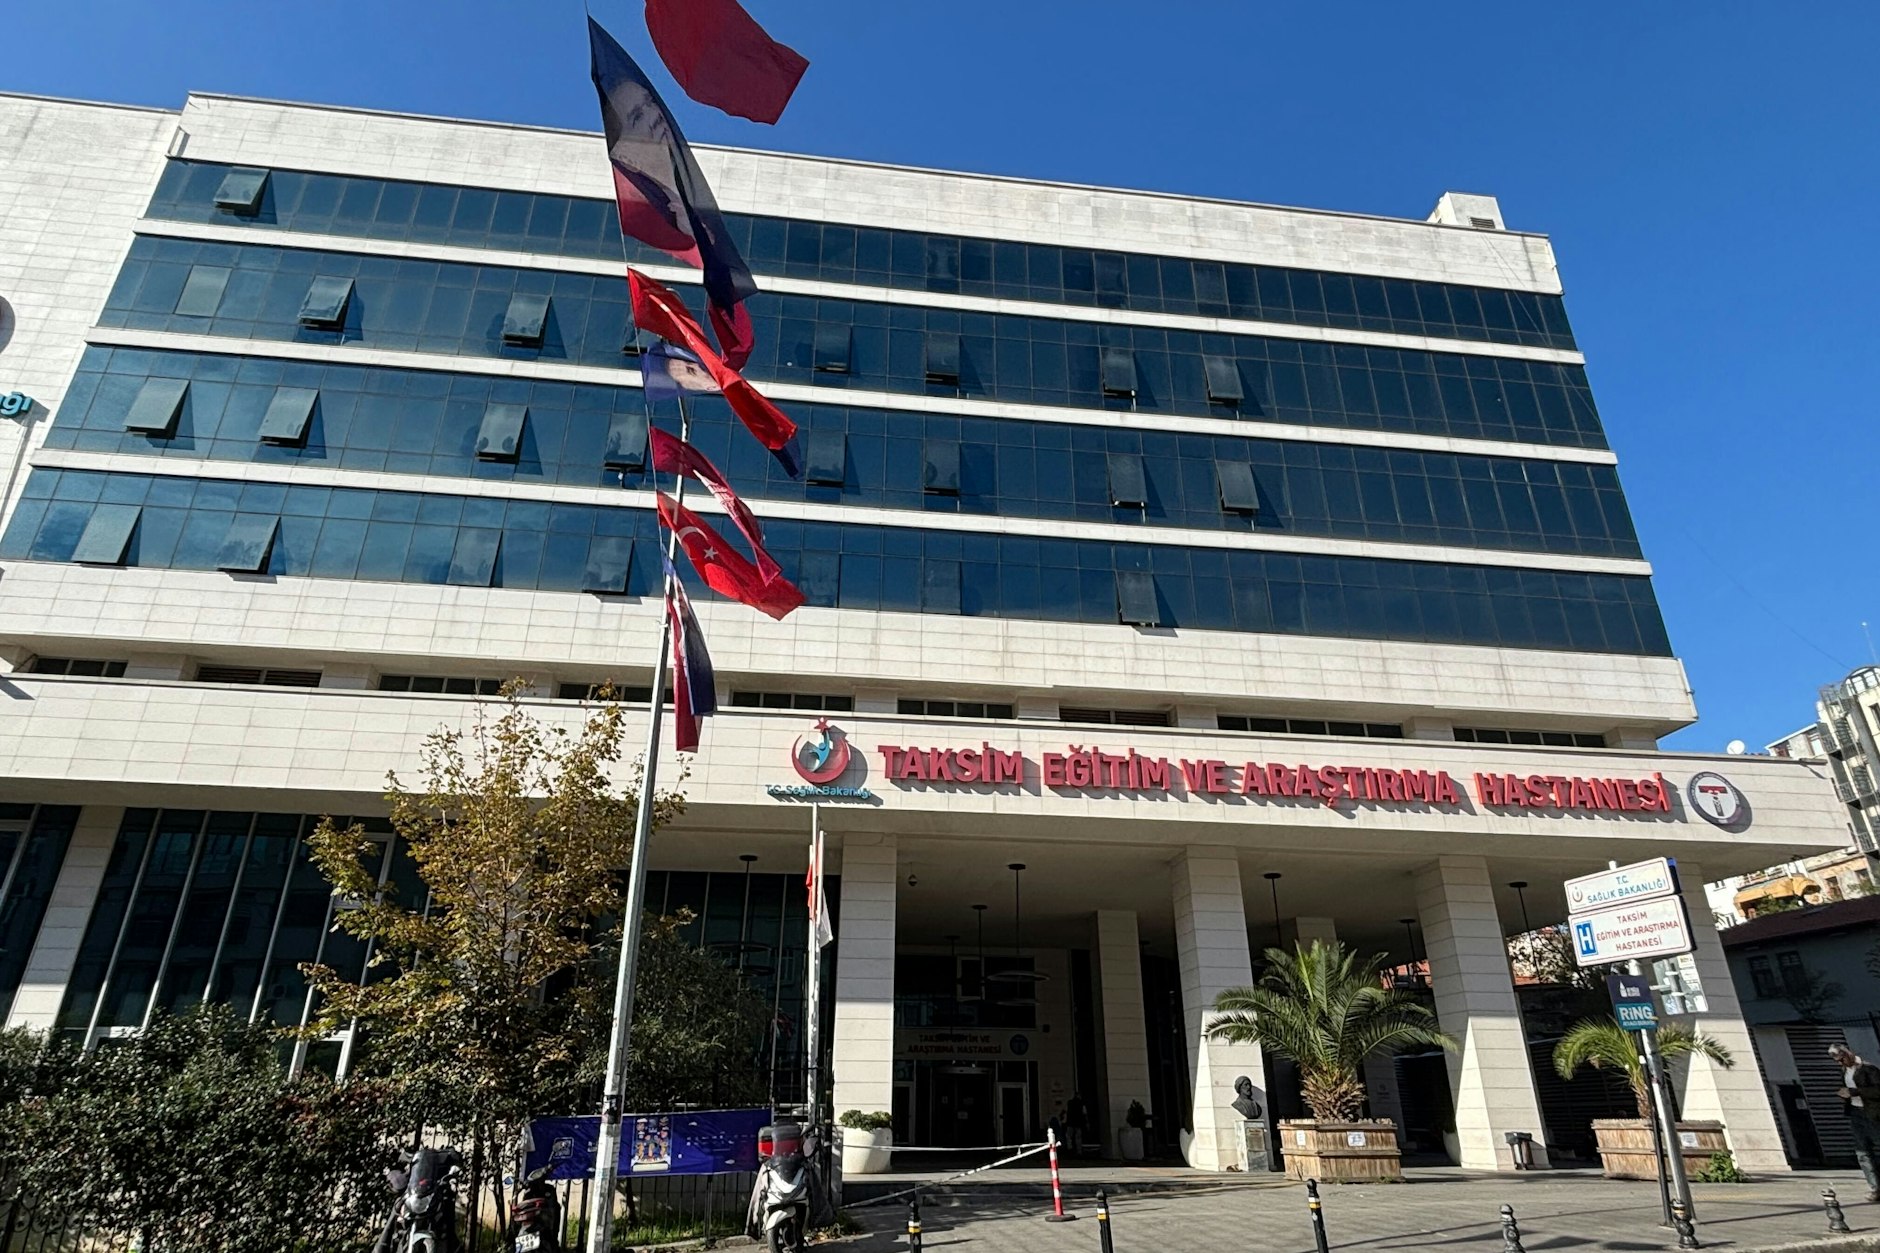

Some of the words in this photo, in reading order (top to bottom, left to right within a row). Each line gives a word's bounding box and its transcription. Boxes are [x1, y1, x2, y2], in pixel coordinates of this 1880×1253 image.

[0, 391, 33, 416] ğı
[878, 742, 1025, 785] TAKSİM
[1042, 743, 1172, 791] EĞİTİM
[1178, 758, 1230, 794] VE
[1238, 761, 1461, 808] ARAŞTIRMA
[1472, 771, 1671, 812] HASTANESİ
[1587, 889, 1617, 904] SAĞLIK
[1617, 878, 1667, 897] BAKANLIĞI
[1616, 910, 1648, 924] TAKSİM
[1596, 930, 1621, 941] EĞİTİM
[1621, 928, 1632, 937] VE
[1633, 920, 1680, 935] ARAŞTIRMA
[1615, 935, 1663, 951] HASTANESİ
